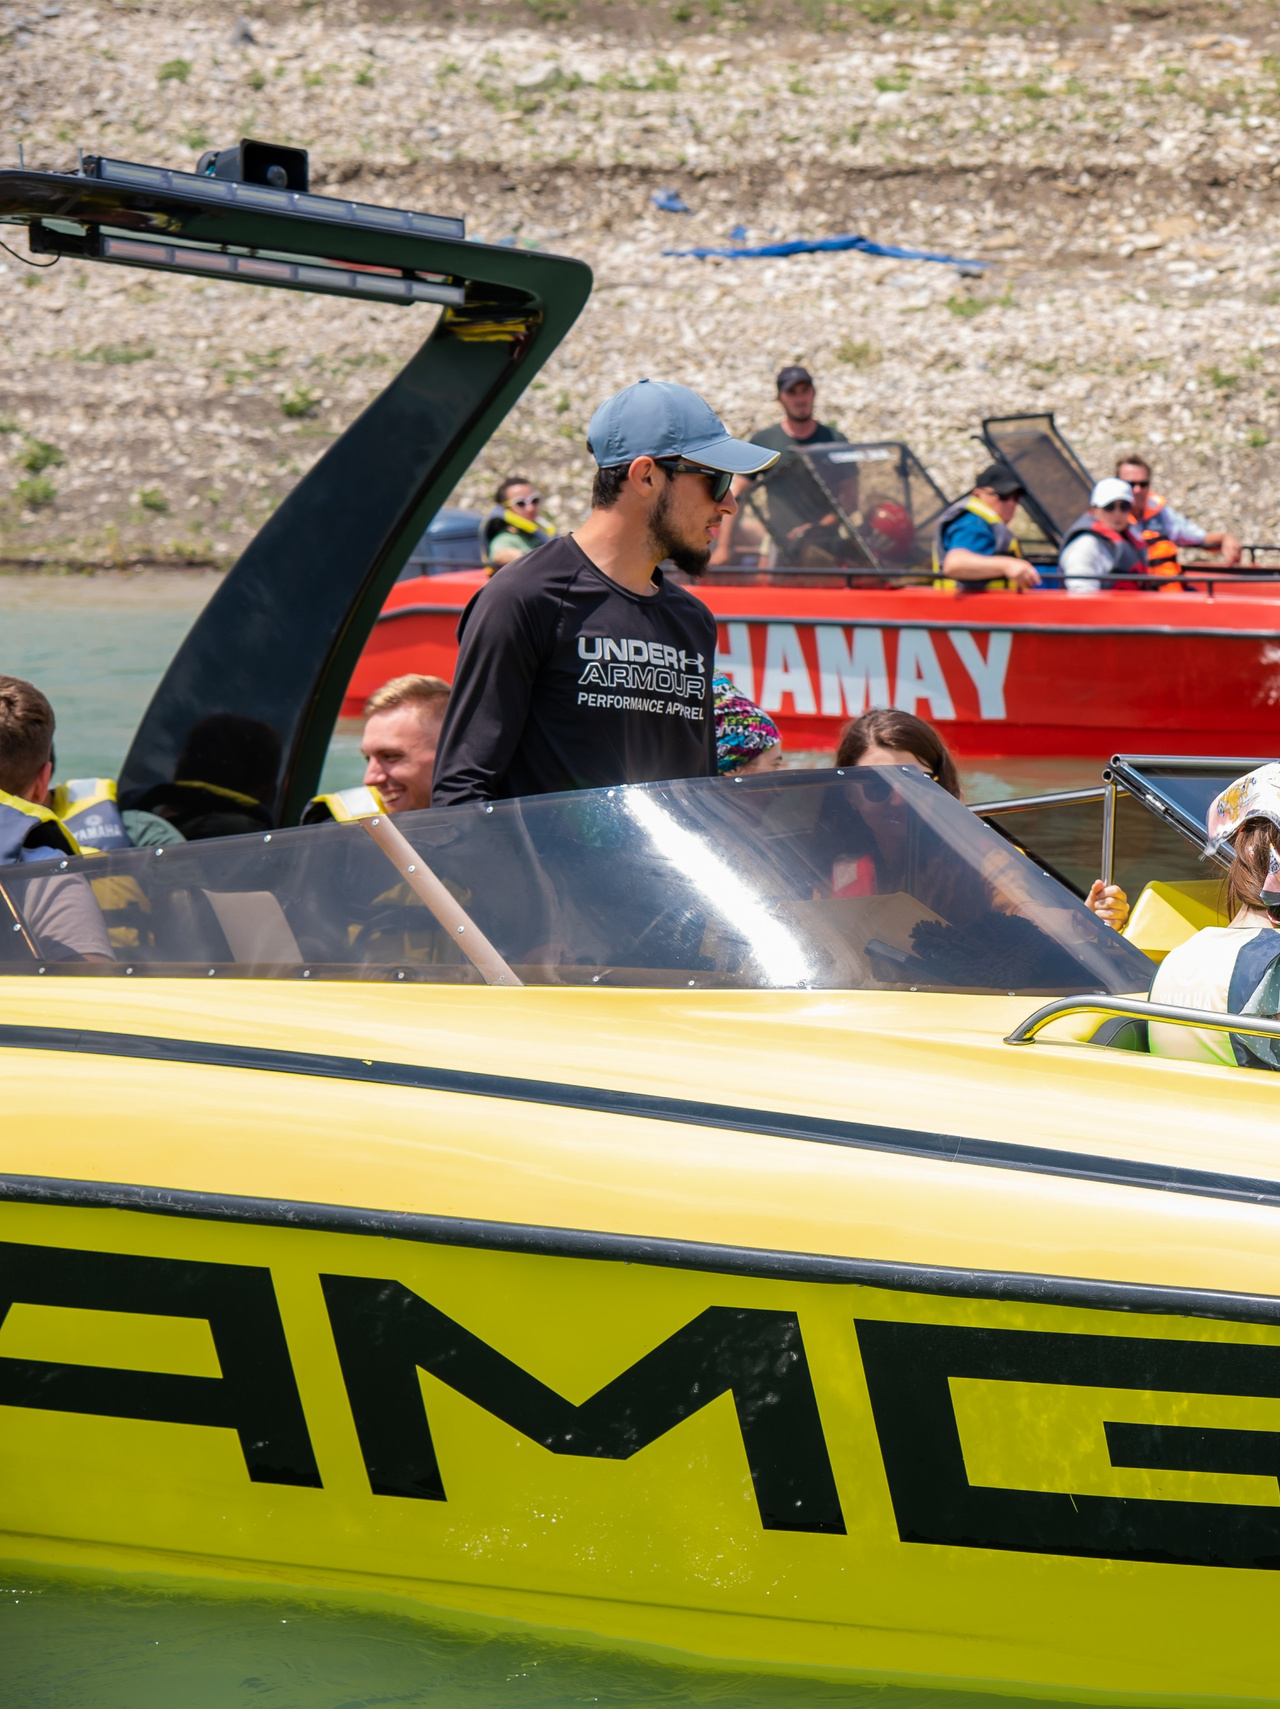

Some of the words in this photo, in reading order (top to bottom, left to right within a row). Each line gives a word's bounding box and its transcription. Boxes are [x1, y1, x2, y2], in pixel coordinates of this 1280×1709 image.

[578, 637, 679, 669] UNDER
[578, 662, 706, 700] ARMOUR
[577, 692, 664, 714] PERFORMANCE
[665, 701, 704, 720] APPREL
[73, 823, 123, 840] YAMAHA
